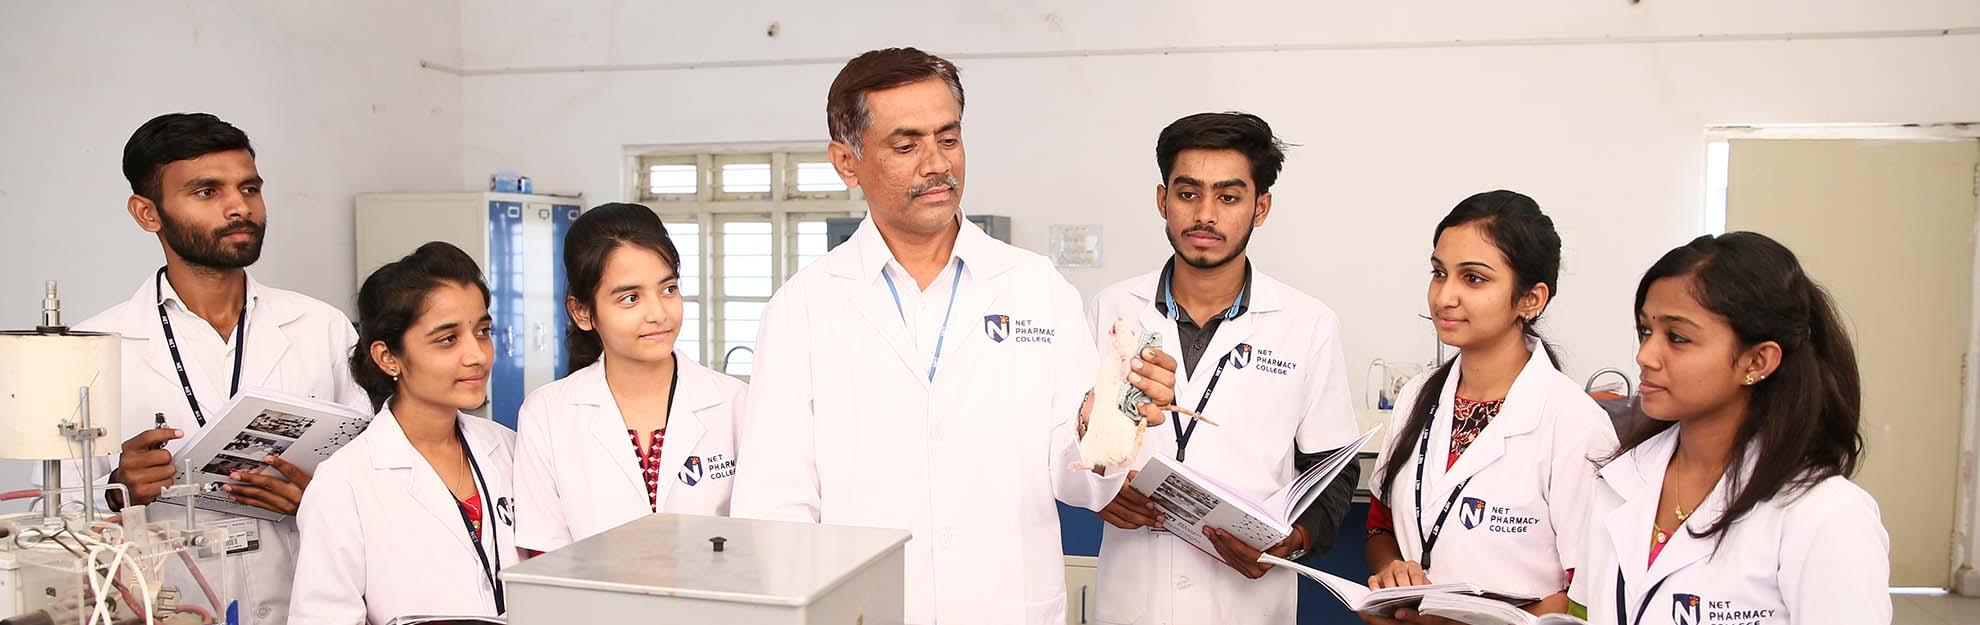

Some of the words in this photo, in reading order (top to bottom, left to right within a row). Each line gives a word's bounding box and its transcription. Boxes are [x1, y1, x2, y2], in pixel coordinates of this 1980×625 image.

[985, 318, 1008, 342] N
[1015, 328, 1055, 336] PHARMAC
[1229, 347, 1250, 369] N
[1256, 356, 1297, 370] PHARMACY
[1255, 364, 1288, 375] COLLEGE
[707, 454, 723, 463] NET
[708, 459, 735, 472] PHARM
[710, 468, 735, 480] COLLE
[1460, 500, 1482, 529] N
[1491, 507, 1511, 515] NET
[1490, 515, 1541, 525] PHARMACY
[1489, 525, 1528, 533] COLLEGE
[1708, 600, 1732, 609] NET
[1709, 609, 1775, 621] PHARMACY
